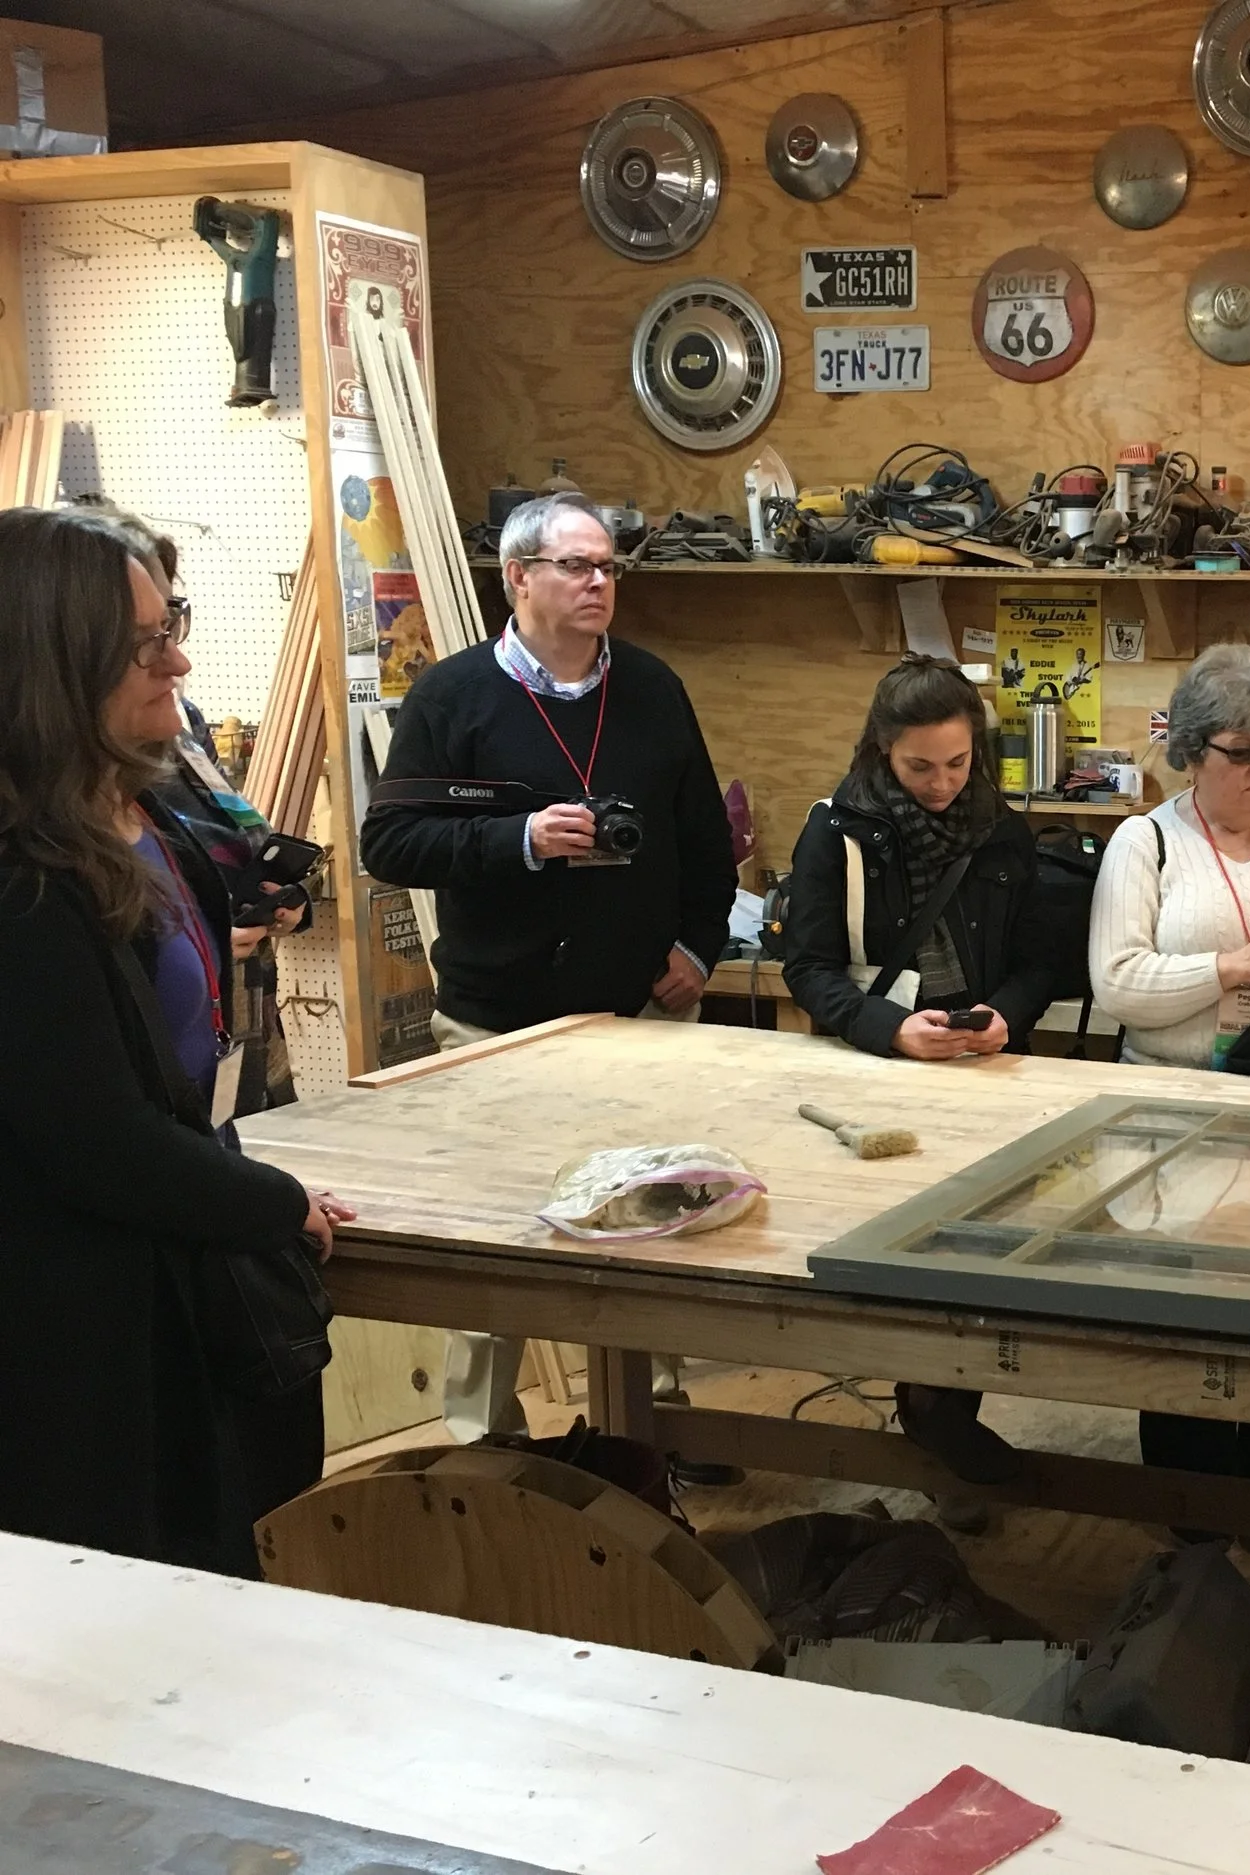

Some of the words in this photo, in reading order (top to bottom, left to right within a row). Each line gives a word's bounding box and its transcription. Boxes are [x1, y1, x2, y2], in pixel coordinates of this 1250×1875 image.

[343, 233, 401, 261] 999
[832, 252, 885, 262] TEXAS
[346, 253, 400, 276] EYES
[836, 266, 909, 297] GC51RH
[995, 274, 1057, 296] ROUTE
[1013, 302, 1034, 312] US
[857, 330, 887, 340] TEXAS
[1001, 312, 1053, 357] 66
[857, 340, 887, 348] TRUCK
[820, 349, 865, 381] 3FN
[877, 347, 922, 380] J77
[1010, 606, 1088, 625] Skylark
[1030, 660, 1056, 668] EDDIE
[1038, 673, 1064, 681] STOUT
[1077, 720, 1096, 728] 2015
[449, 785, 495, 798] Canon
[384, 923, 412, 939] FOLK
